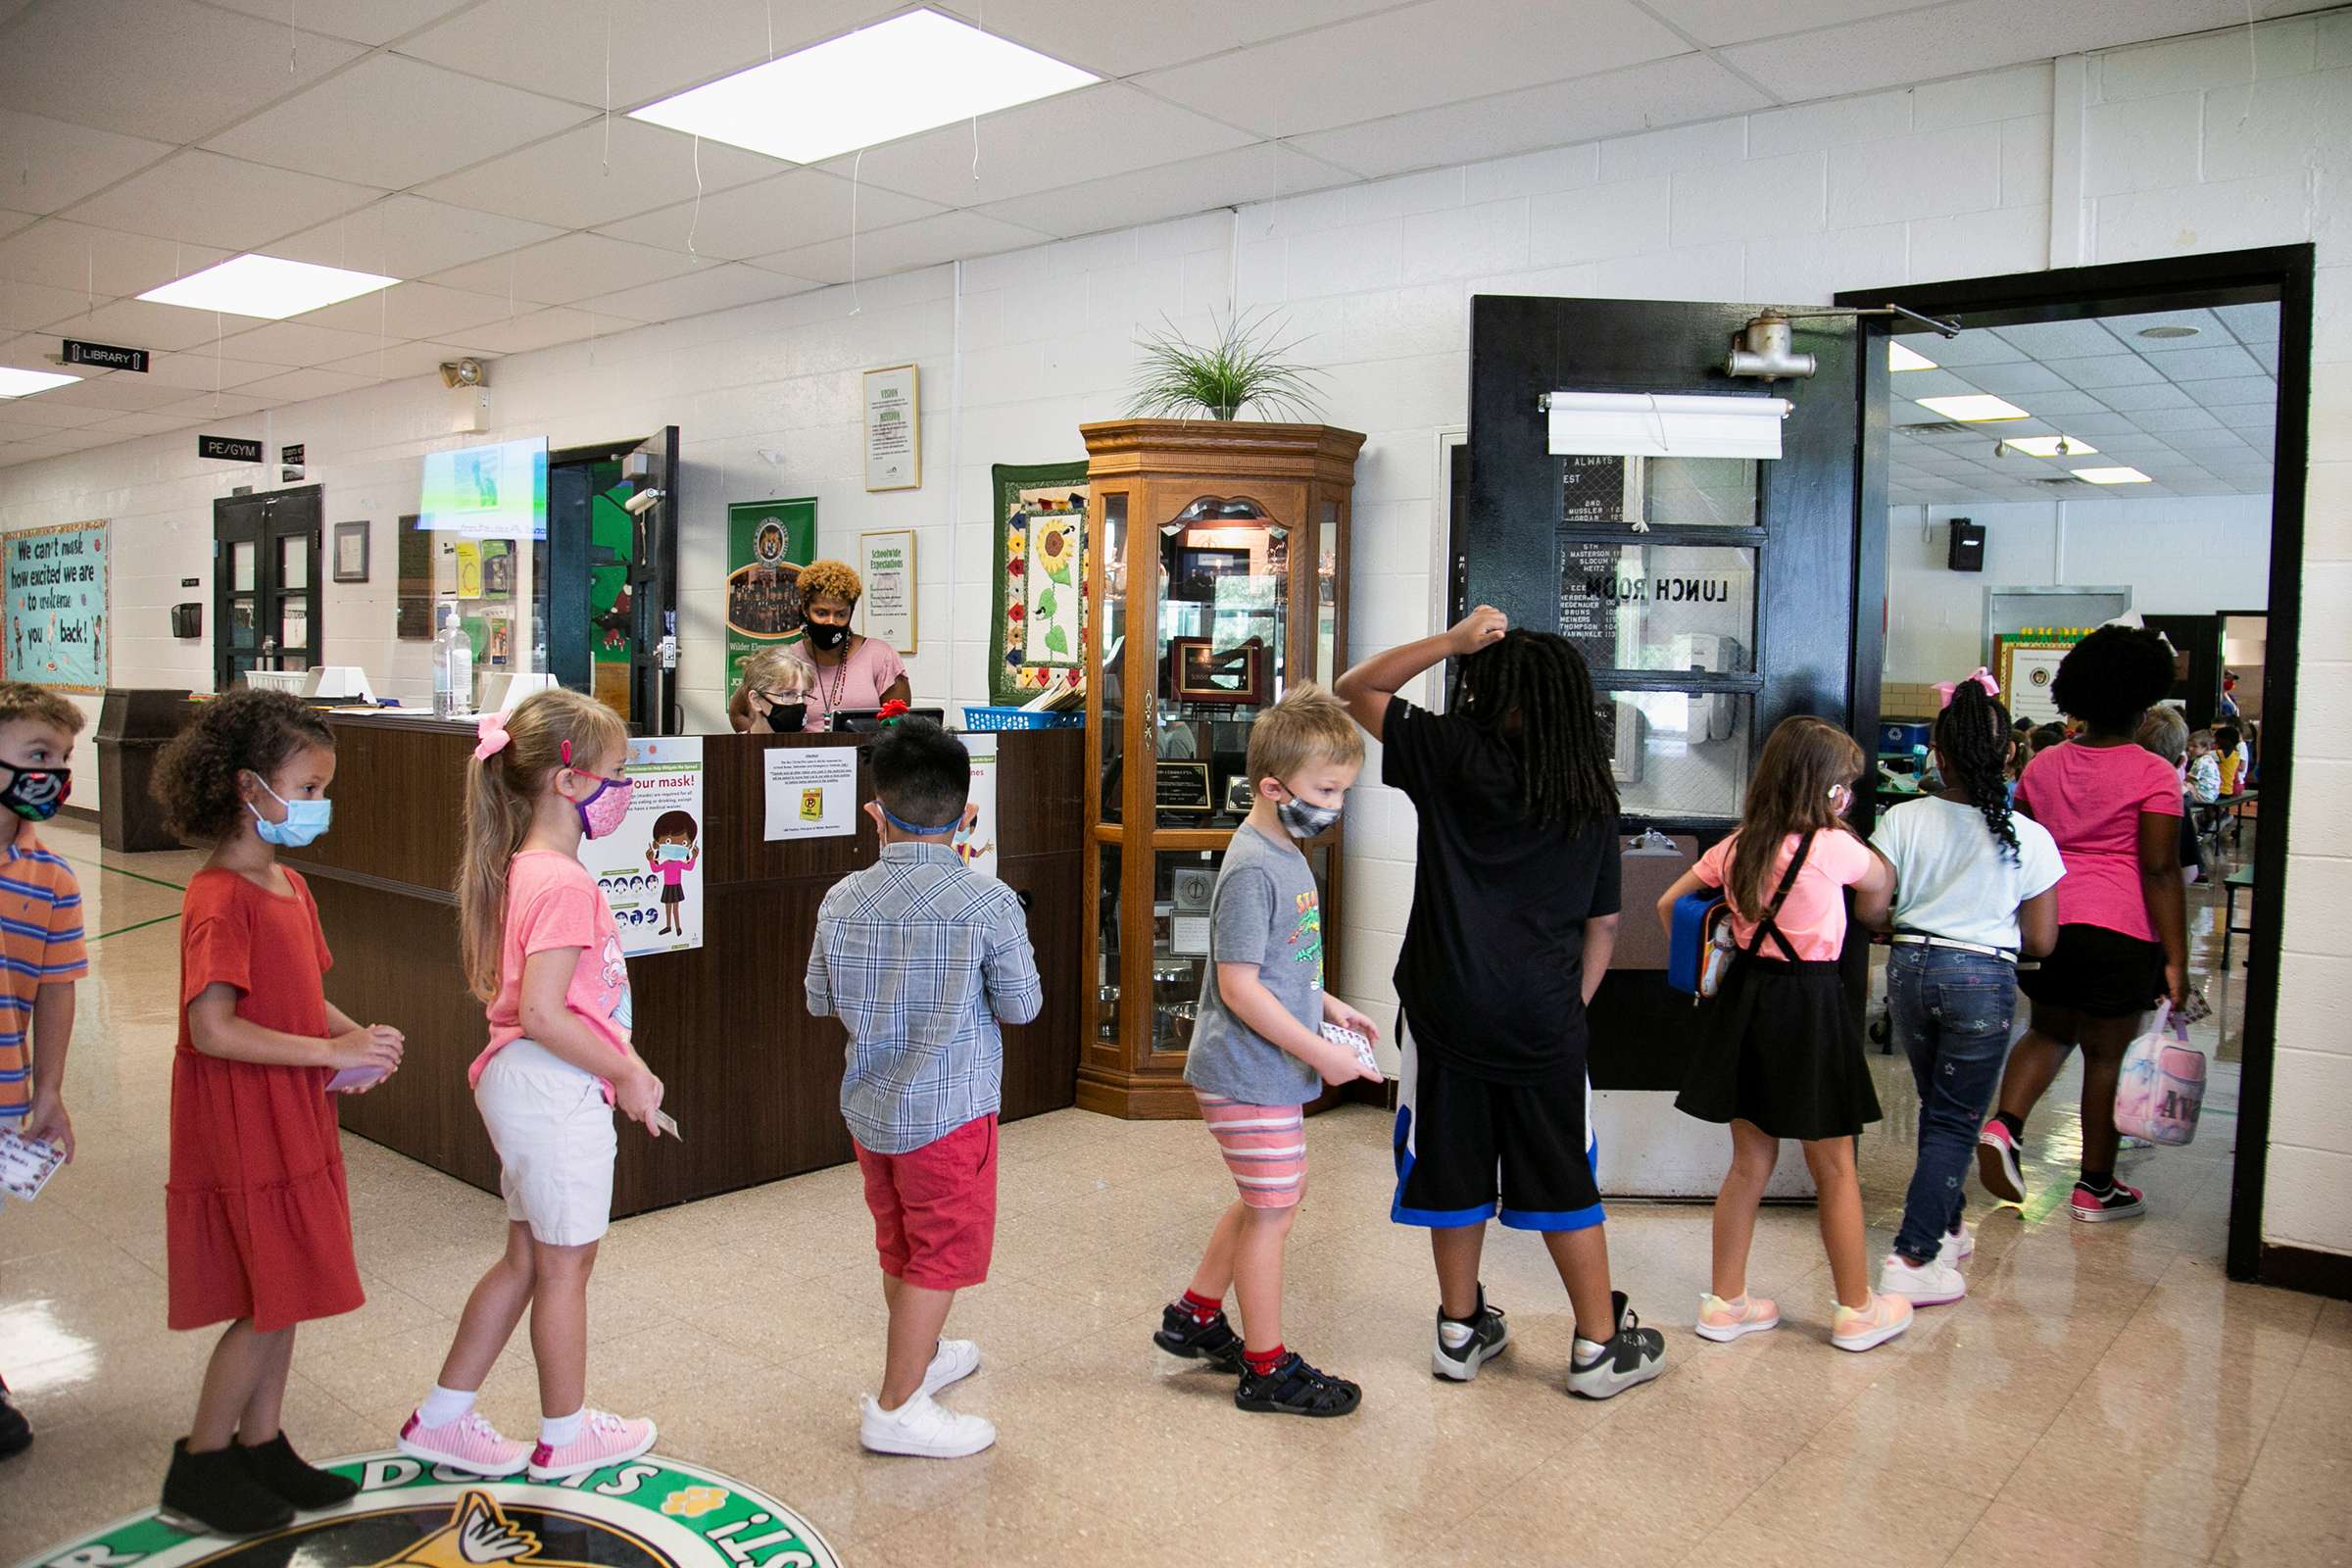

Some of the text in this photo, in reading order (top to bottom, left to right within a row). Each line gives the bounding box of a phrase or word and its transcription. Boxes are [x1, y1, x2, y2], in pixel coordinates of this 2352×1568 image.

[83, 349, 130, 364] LIBRARY
[209, 441, 255, 457] PE/GYM
[1575, 456, 1613, 466] ALWAYS
[1563, 474, 1581, 483] EST
[19, 532, 83, 561] We can't mask
[871, 549, 901, 559] Schoolwide
[11, 561, 94, 589] how excited we are
[27, 592, 36, 612] to
[27, 626, 43, 651] you
[634, 774, 695, 789] our mask!
